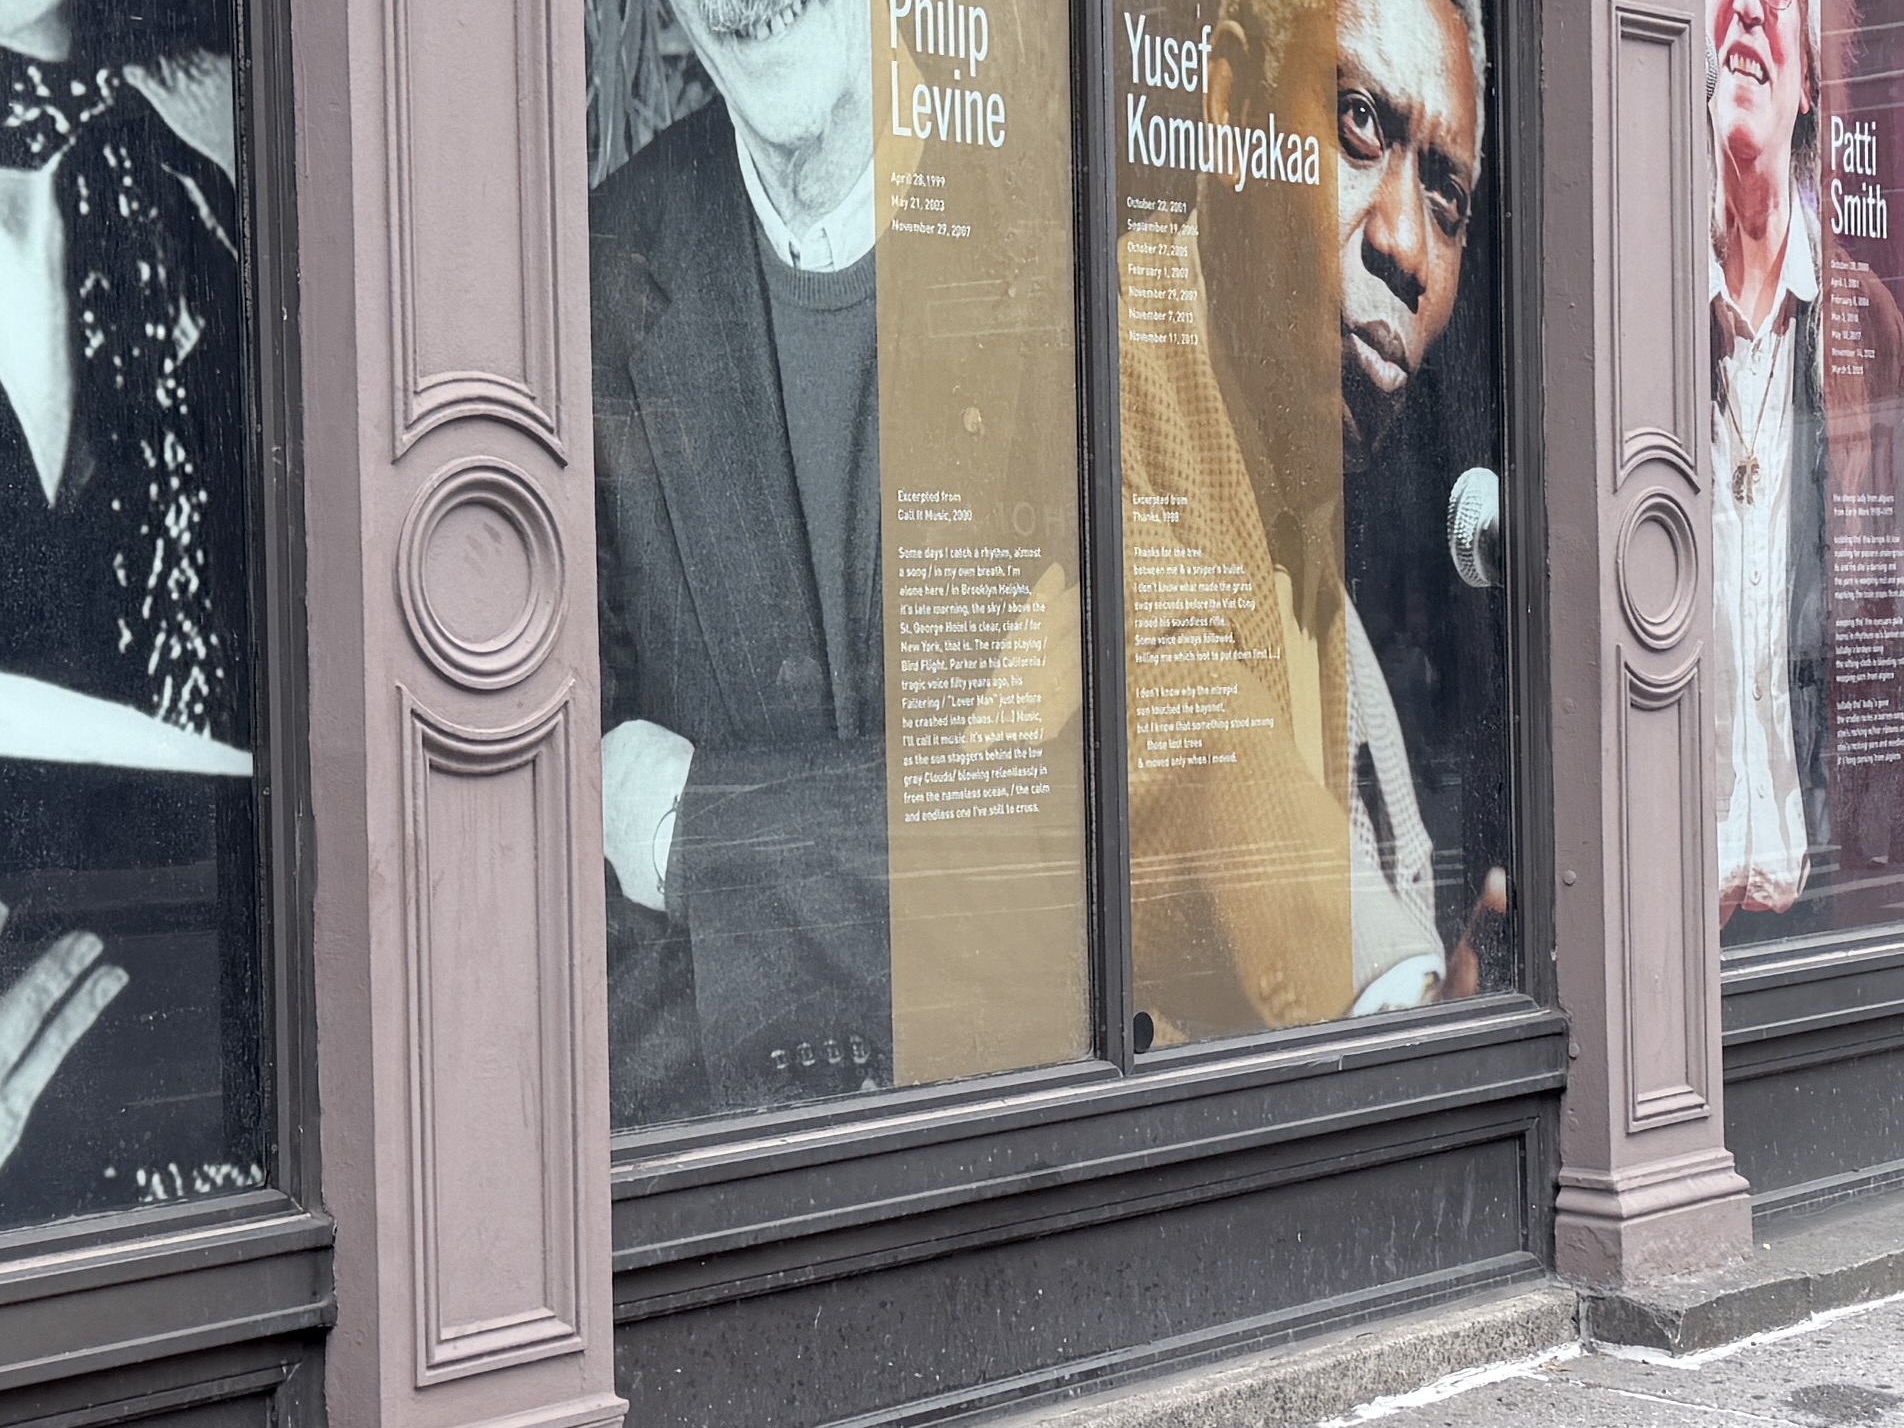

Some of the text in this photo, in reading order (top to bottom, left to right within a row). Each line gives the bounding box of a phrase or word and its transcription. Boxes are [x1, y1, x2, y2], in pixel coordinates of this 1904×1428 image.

[1124, 12, 1212, 94] Yusef
[892, 60, 1005, 149] Levine
[1127, 93, 1320, 192] Komunyakaa
[1831, 116, 1876, 176] Patti
[1831, 179, 1887, 239] Smith
